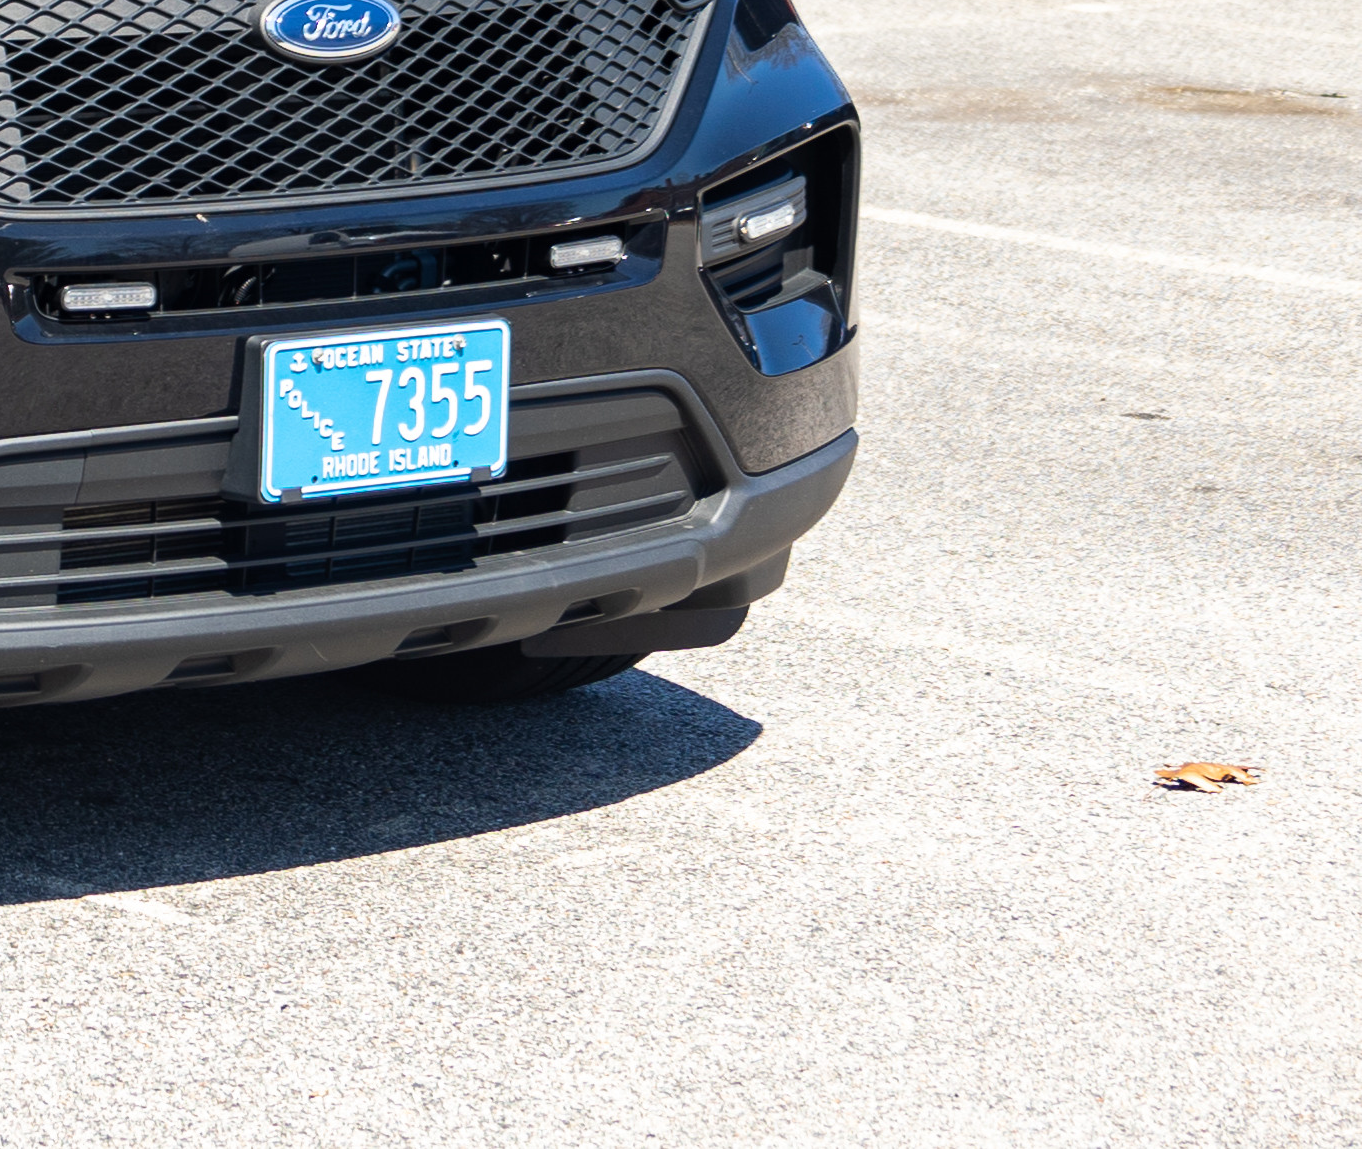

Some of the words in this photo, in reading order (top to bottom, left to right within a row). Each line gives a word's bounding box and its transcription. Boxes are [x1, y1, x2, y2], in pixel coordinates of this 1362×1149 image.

[303, 3, 373, 41] Ford
[323, 344, 384, 369] OCEAN
[396, 337, 454, 362] STATE
[280, 379, 345, 451] POLICE
[365, 360, 492, 445] 7355
[322, 451, 380, 479] RHODE
[389, 443, 452, 471] ISLAND
